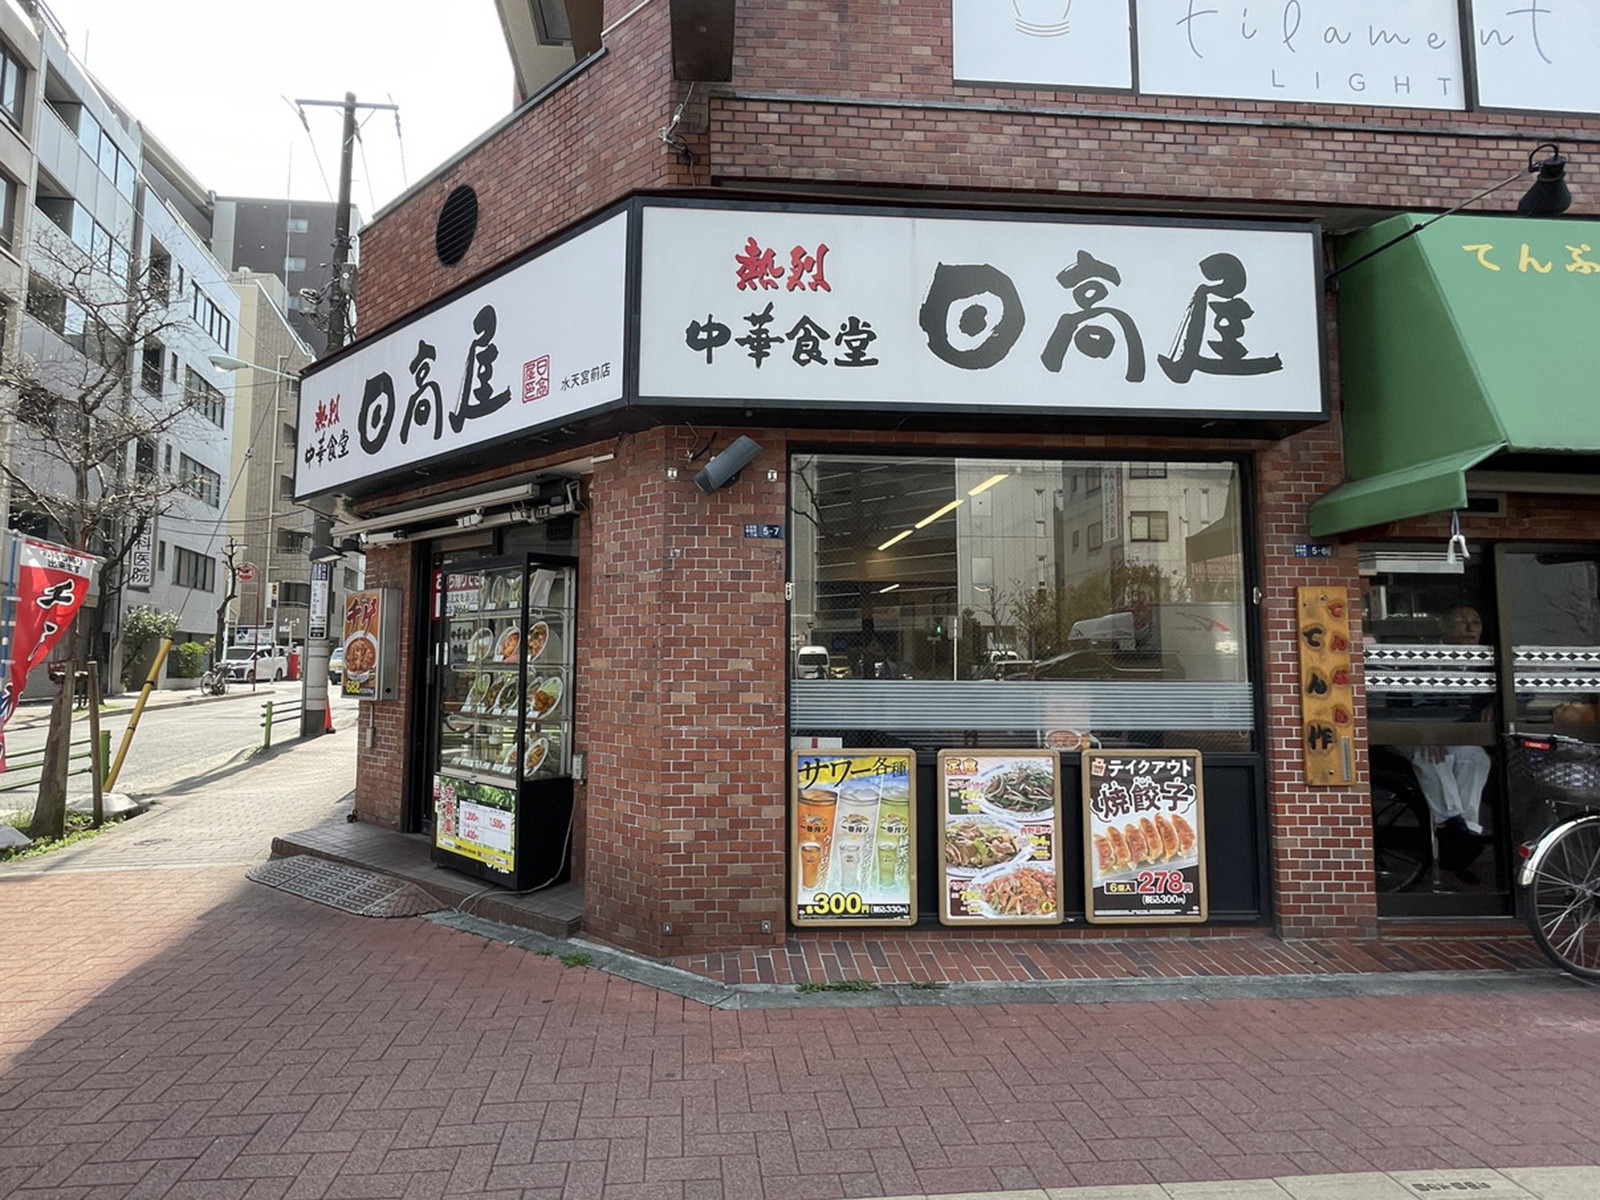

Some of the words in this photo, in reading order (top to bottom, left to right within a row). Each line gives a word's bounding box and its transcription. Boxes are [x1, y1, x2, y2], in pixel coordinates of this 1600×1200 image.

[1272, 70, 1452, 96] LIGHT
[735, 236, 832, 292] 熱烈
[685, 301, 880, 369] 中華食堂
[918, 250, 1284, 385] 日高屋
[358, 304, 512, 455] 日高屋
[560, 361, 611, 392] 水天宮前店
[314, 393, 341, 434] 熱烈
[304, 429, 350, 470] 中華食堂
[798, 756, 908, 790] サワー各種
[1108, 759, 1192, 777] テイクアウト
[1100, 780, 1190, 819] 焼餃子
[1138, 871, 1193, 894] 278円
